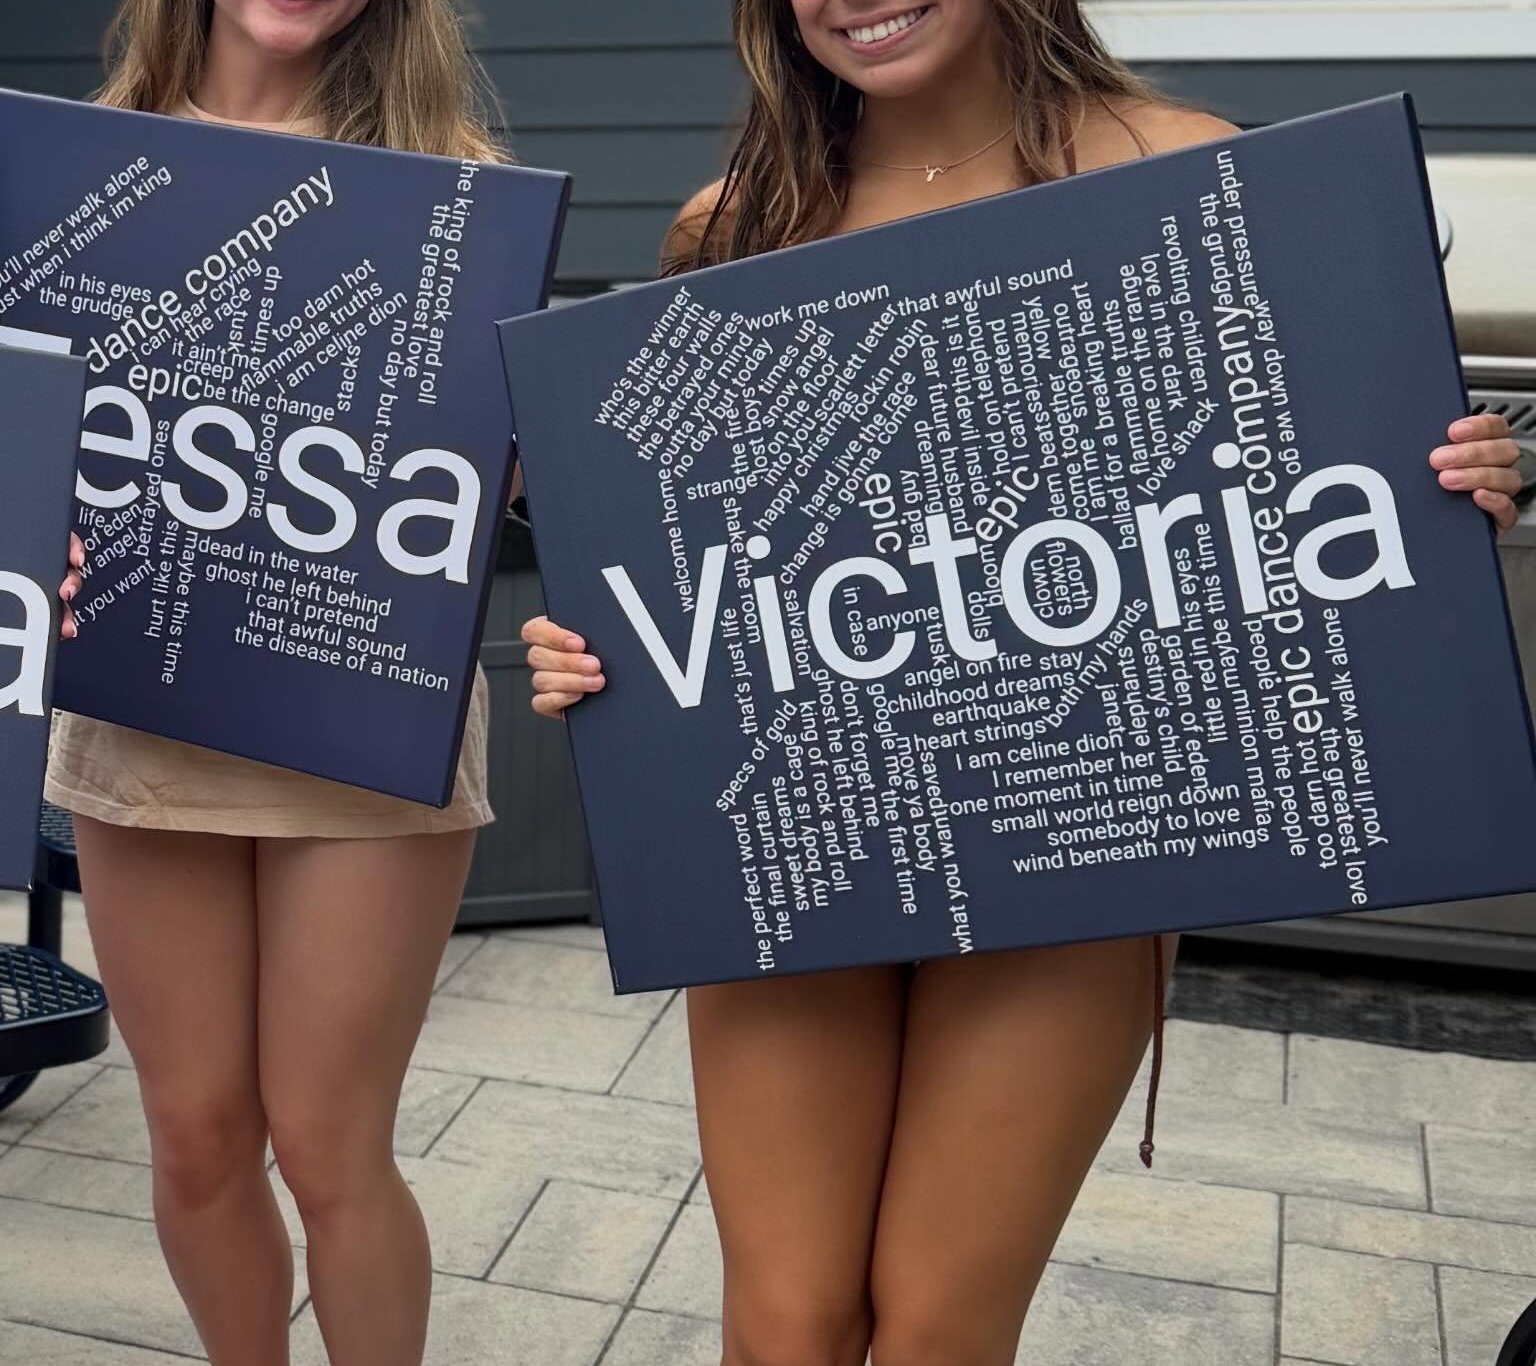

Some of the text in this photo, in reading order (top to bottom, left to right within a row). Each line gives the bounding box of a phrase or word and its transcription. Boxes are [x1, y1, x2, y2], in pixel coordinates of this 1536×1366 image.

[20, 254, 63, 292] when
[61, 244, 71, 259] i
[70, 213, 112, 252] think
[109, 196, 135, 219] im
[131, 166, 172, 201] king
[22, 223, 65, 265] never
[65, 192, 105, 228] walk
[104, 155, 150, 197] alone
[59, 271, 152, 303] in his eyes
[86, 166, 334, 374] dance company
[898, 259, 1073, 316] that awful sound
[39, 286, 133, 321] the grudge
[744, 284, 889, 332] work me down
[128, 363, 202, 402] epic
[858, 473, 907, 554] epic
[1212, 305, 1329, 734] epic dance company
[199, 536, 359, 585] dead in the water
[601, 441, 1416, 710] Victoria
[205, 563, 392, 616] ghost he left behind
[246, 588, 378, 633] i can't pretend
[235, 627, 449, 691] the disease of a nation
[248, 610, 407, 661] that awful sound
[888, 670, 1074, 715] childhood dreams
[903, 650, 1083, 688] angel on fire stay
[915, 717, 1048, 751] heart strings
[933, 694, 1051, 728] earthquake
[956, 732, 1123, 771] I am celine dion
[993, 748, 1155, 788] I remember her
[950, 771, 1163, 816] one moment in time
[991, 782, 1239, 833] small world reign down
[1012, 825, 1269, 872] wind beneath my wings
[1048, 805, 1240, 847] somebody to love
